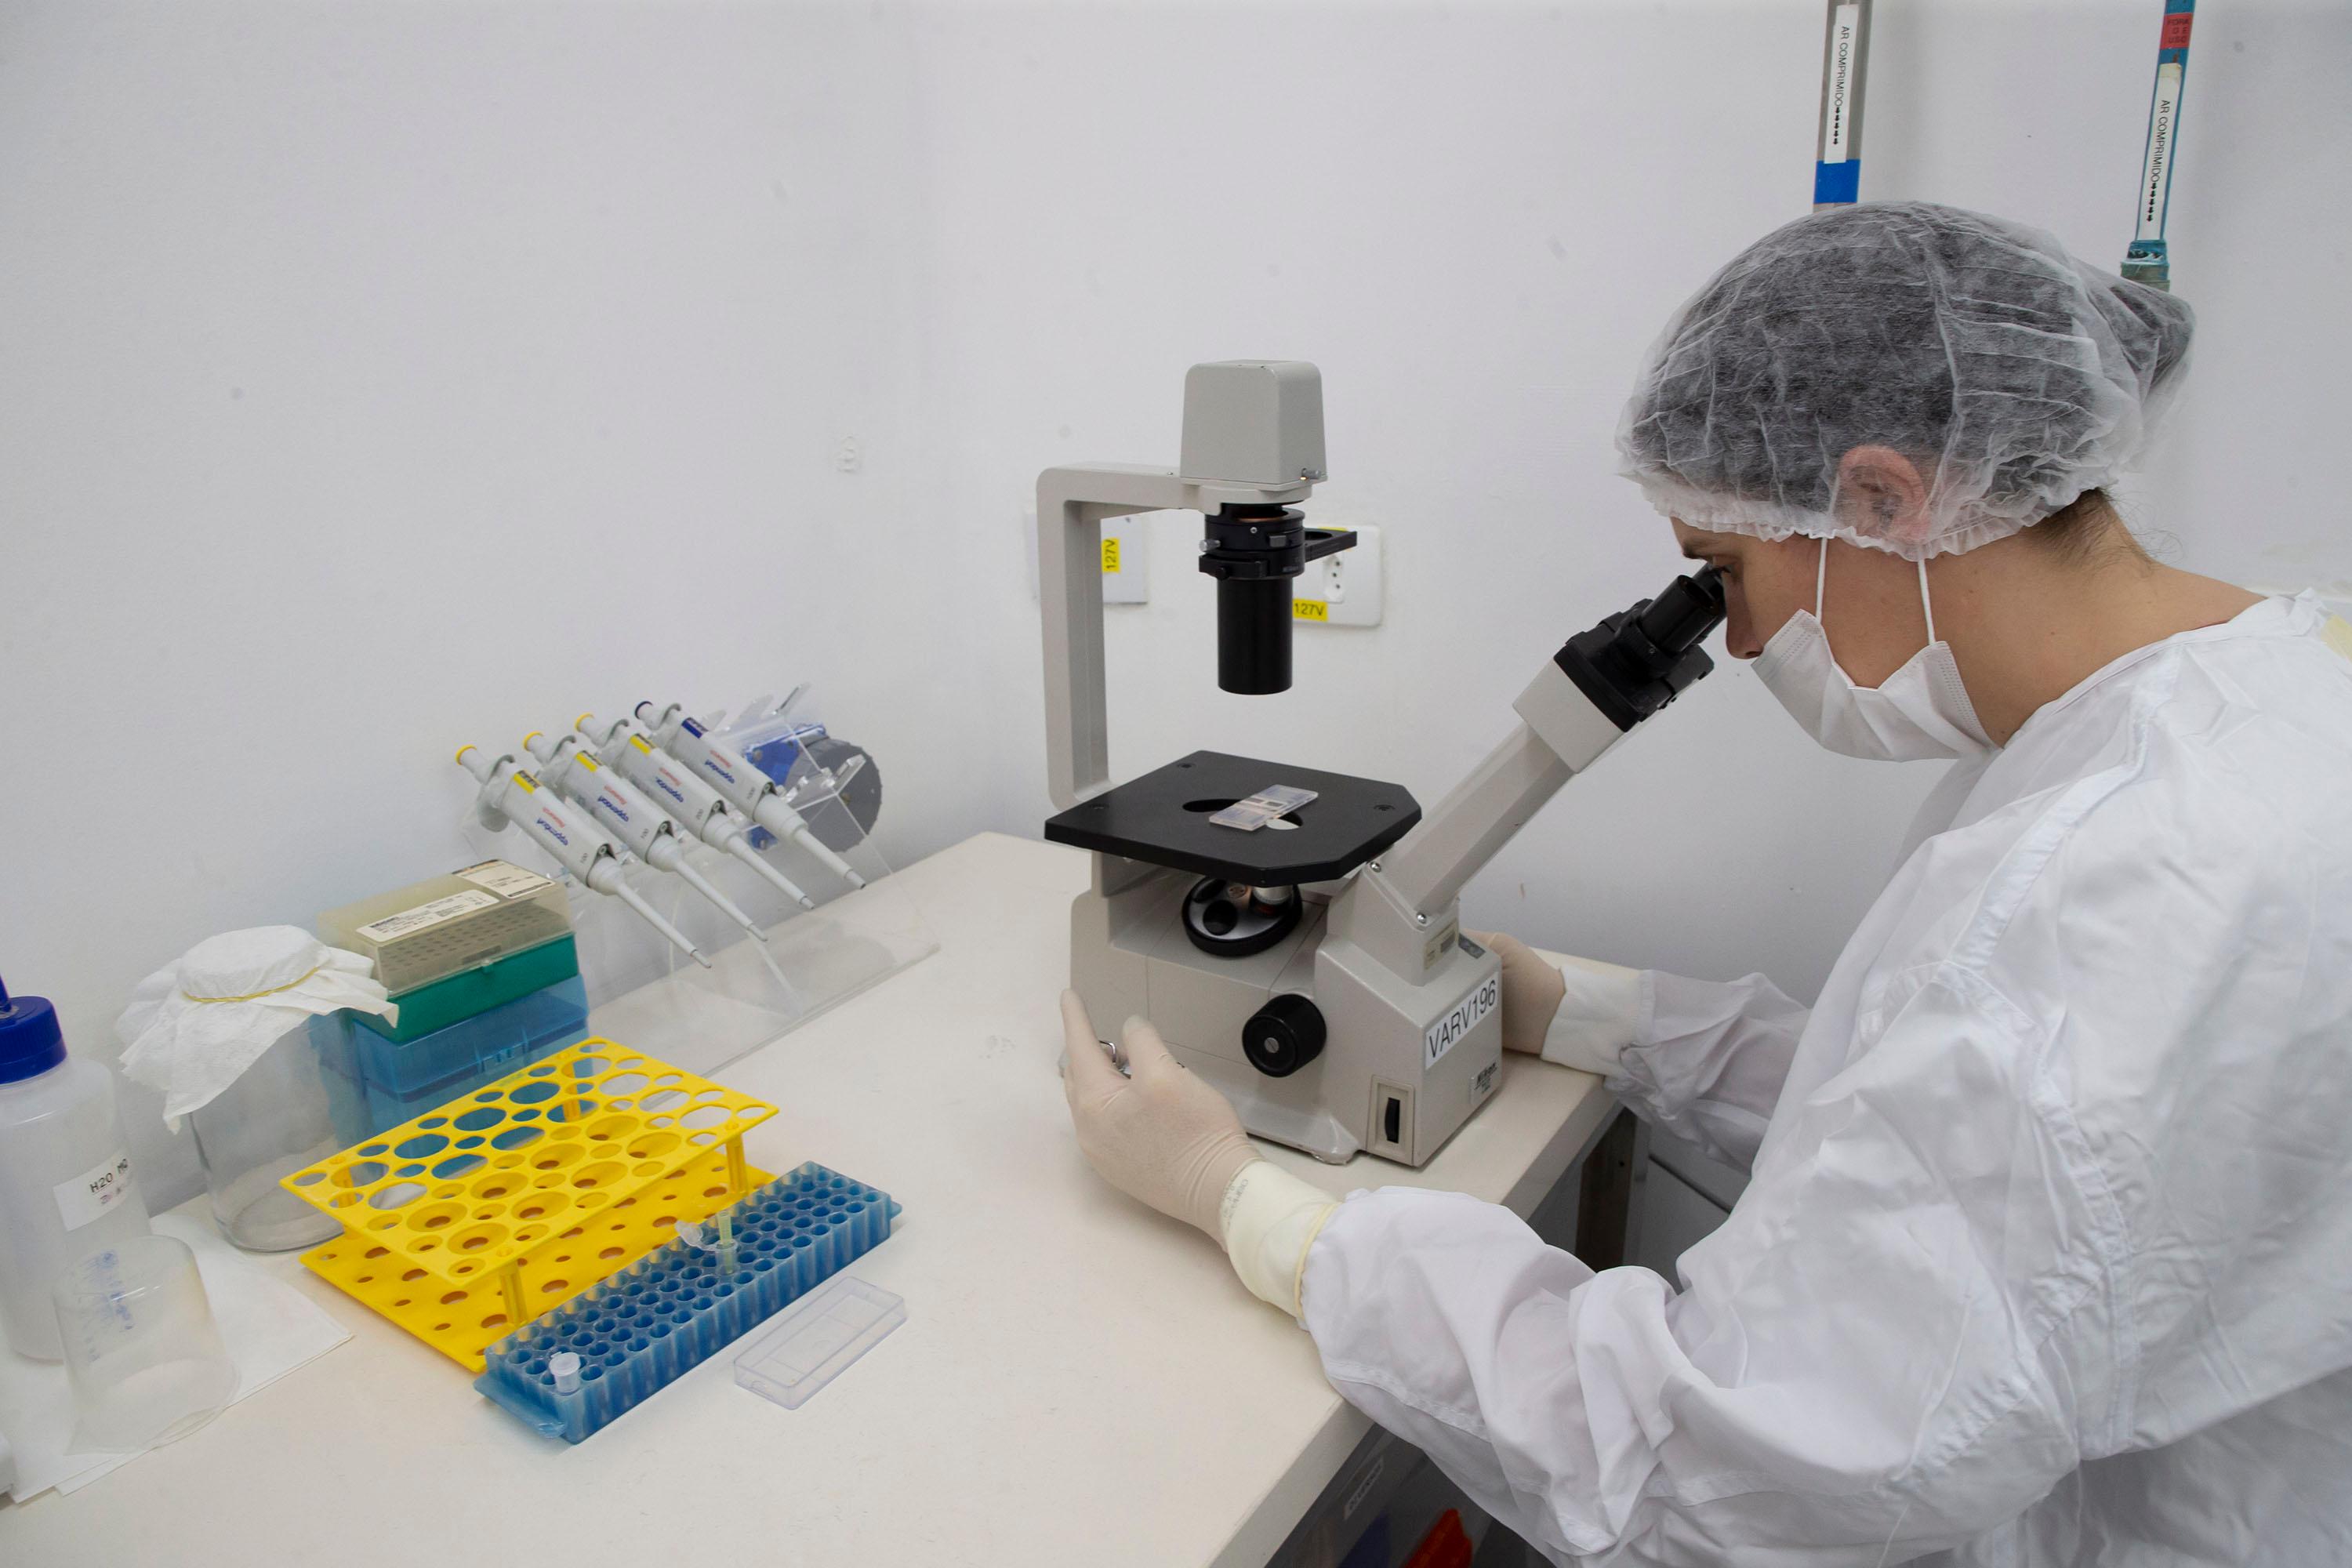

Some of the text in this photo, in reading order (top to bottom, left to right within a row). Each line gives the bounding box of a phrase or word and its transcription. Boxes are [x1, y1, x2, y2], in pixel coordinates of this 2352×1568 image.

[1835, 26, 1850, 107] AR COMPRIMIDO
[2151, 100, 2170, 183] AR COMPRIMIDO
[1105, 539, 1116, 569] 127V
[1294, 602, 1324, 616] 127V
[1428, 979, 1497, 1058] VARV196
